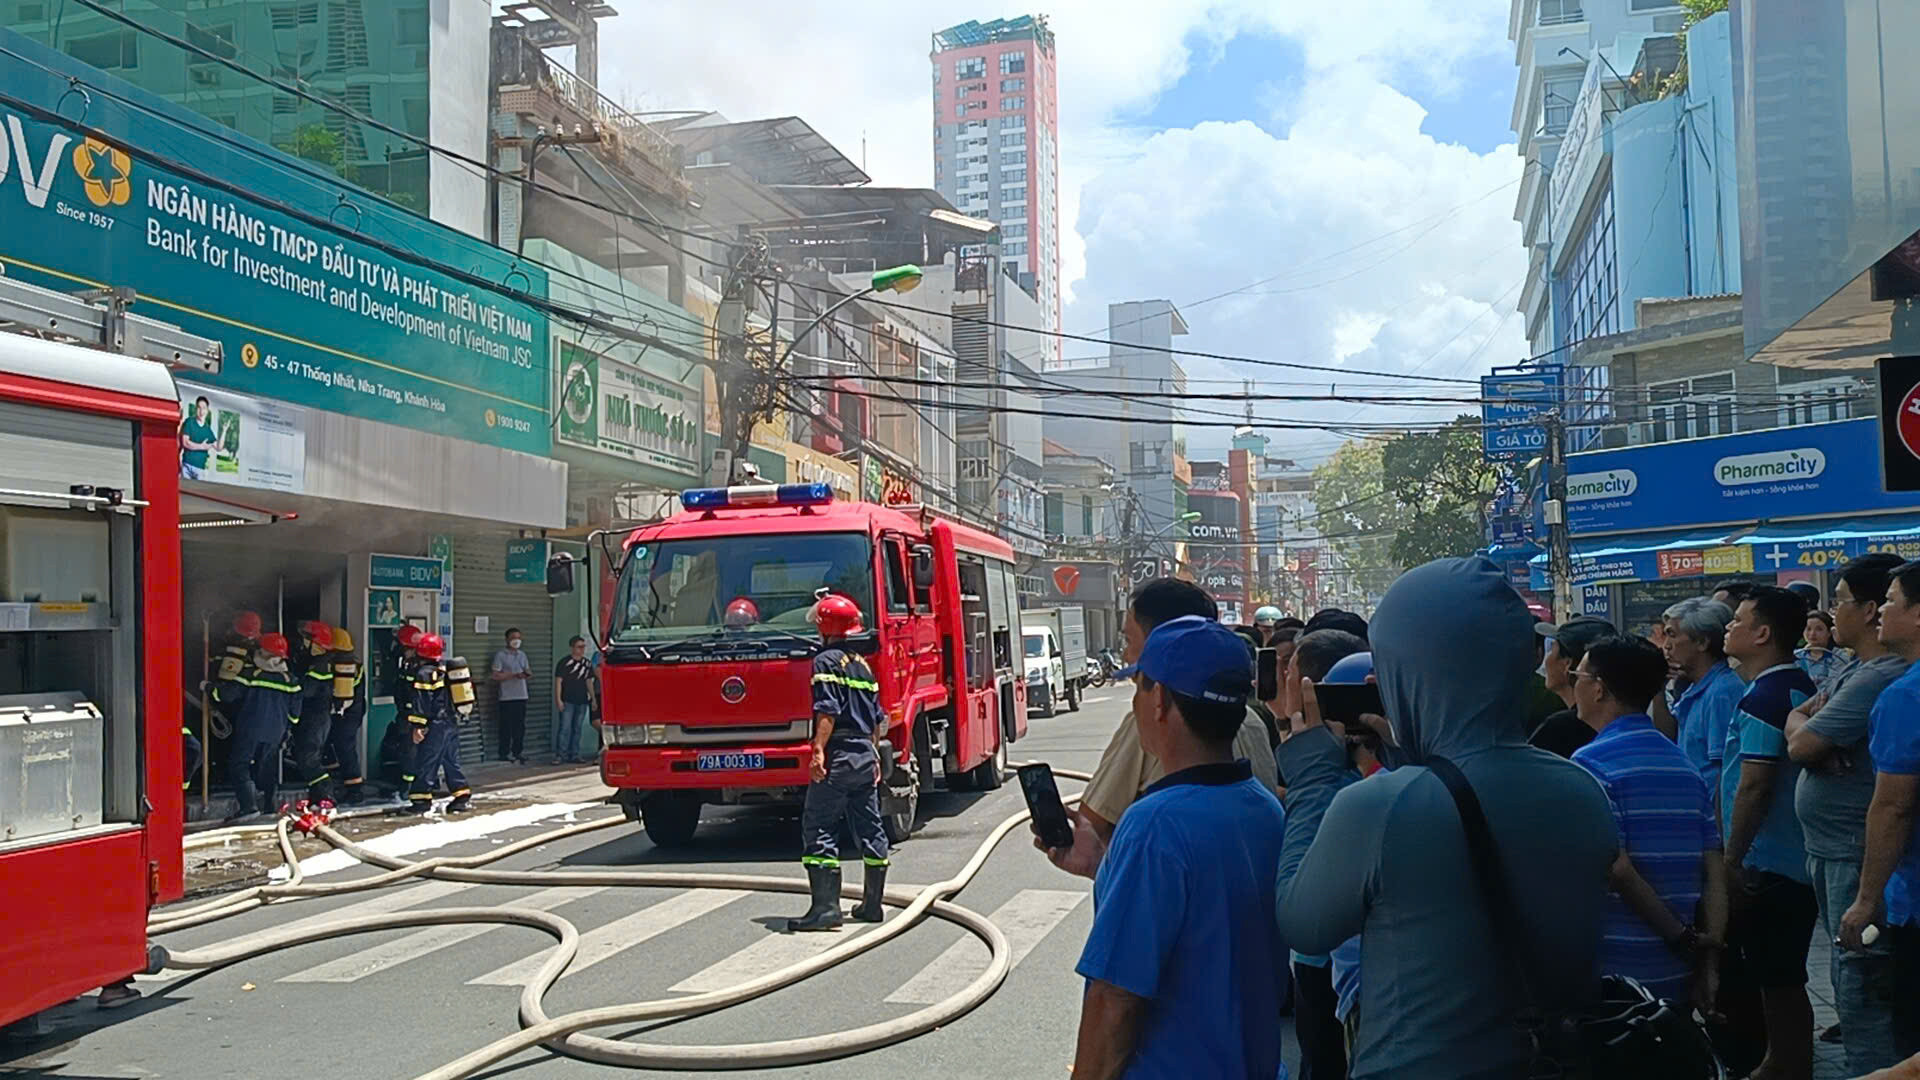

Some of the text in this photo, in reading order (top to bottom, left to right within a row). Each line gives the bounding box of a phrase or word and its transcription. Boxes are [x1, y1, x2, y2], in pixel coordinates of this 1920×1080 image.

[0, 113, 72, 209] V
[56, 201, 115, 231] Since 1957
[147, 179, 532, 342] NGÂN HÀNG TMCP ĐẦU TƯ VÀ PHÁT TRIỂN VIỆT NAM
[147, 217, 532, 369] Bank for Investment and Development of Vietnam JSC
[264, 354, 278, 370] 45
[287, 361, 300, 375] 47
[302, 363, 331, 387] Thống
[358, 379, 376, 395] Nha
[377, 384, 403, 404] Trang,
[404, 391, 429, 409] Khánh
[430, 398, 446, 413] Hòa
[497, 415, 531, 432] 1900 9247
[1496, 432, 1520, 447] GIÁ
[1721, 454, 1817, 480] Pharmacity
[1565, 474, 1630, 496] armacity
[1672, 557, 1691, 569] 70
[1798, 550, 1849, 566] 40%
[410, 566, 432, 581] BIDV
[681, 655, 731, 663] NISSAN
[700, 754, 762, 769] 79A-003.13
